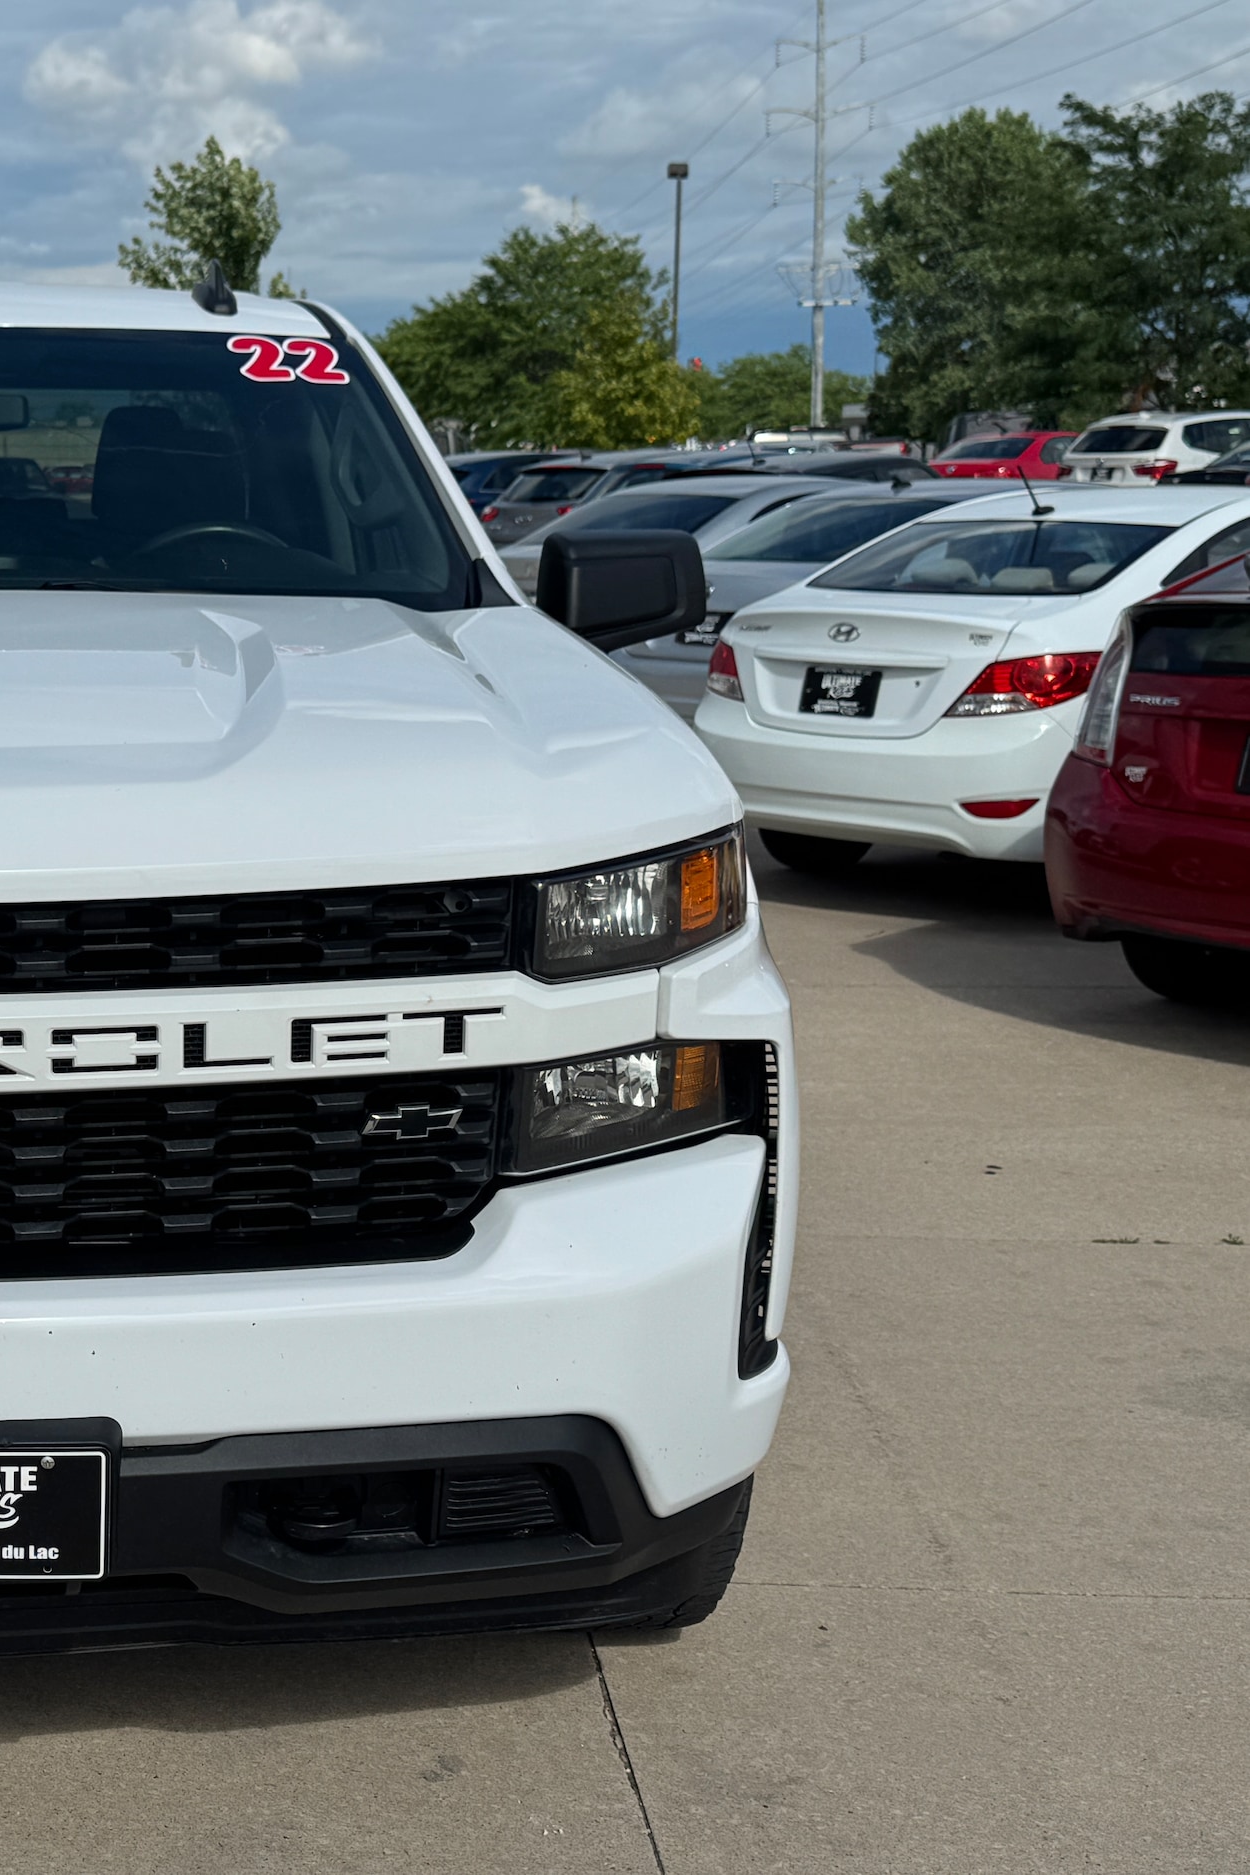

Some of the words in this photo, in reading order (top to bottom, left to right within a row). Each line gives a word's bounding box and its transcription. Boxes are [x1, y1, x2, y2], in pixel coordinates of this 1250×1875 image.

[226, 335, 350, 385] 22
[2, 1545, 25, 1560] du
[28, 1545, 59, 1560] Lac
